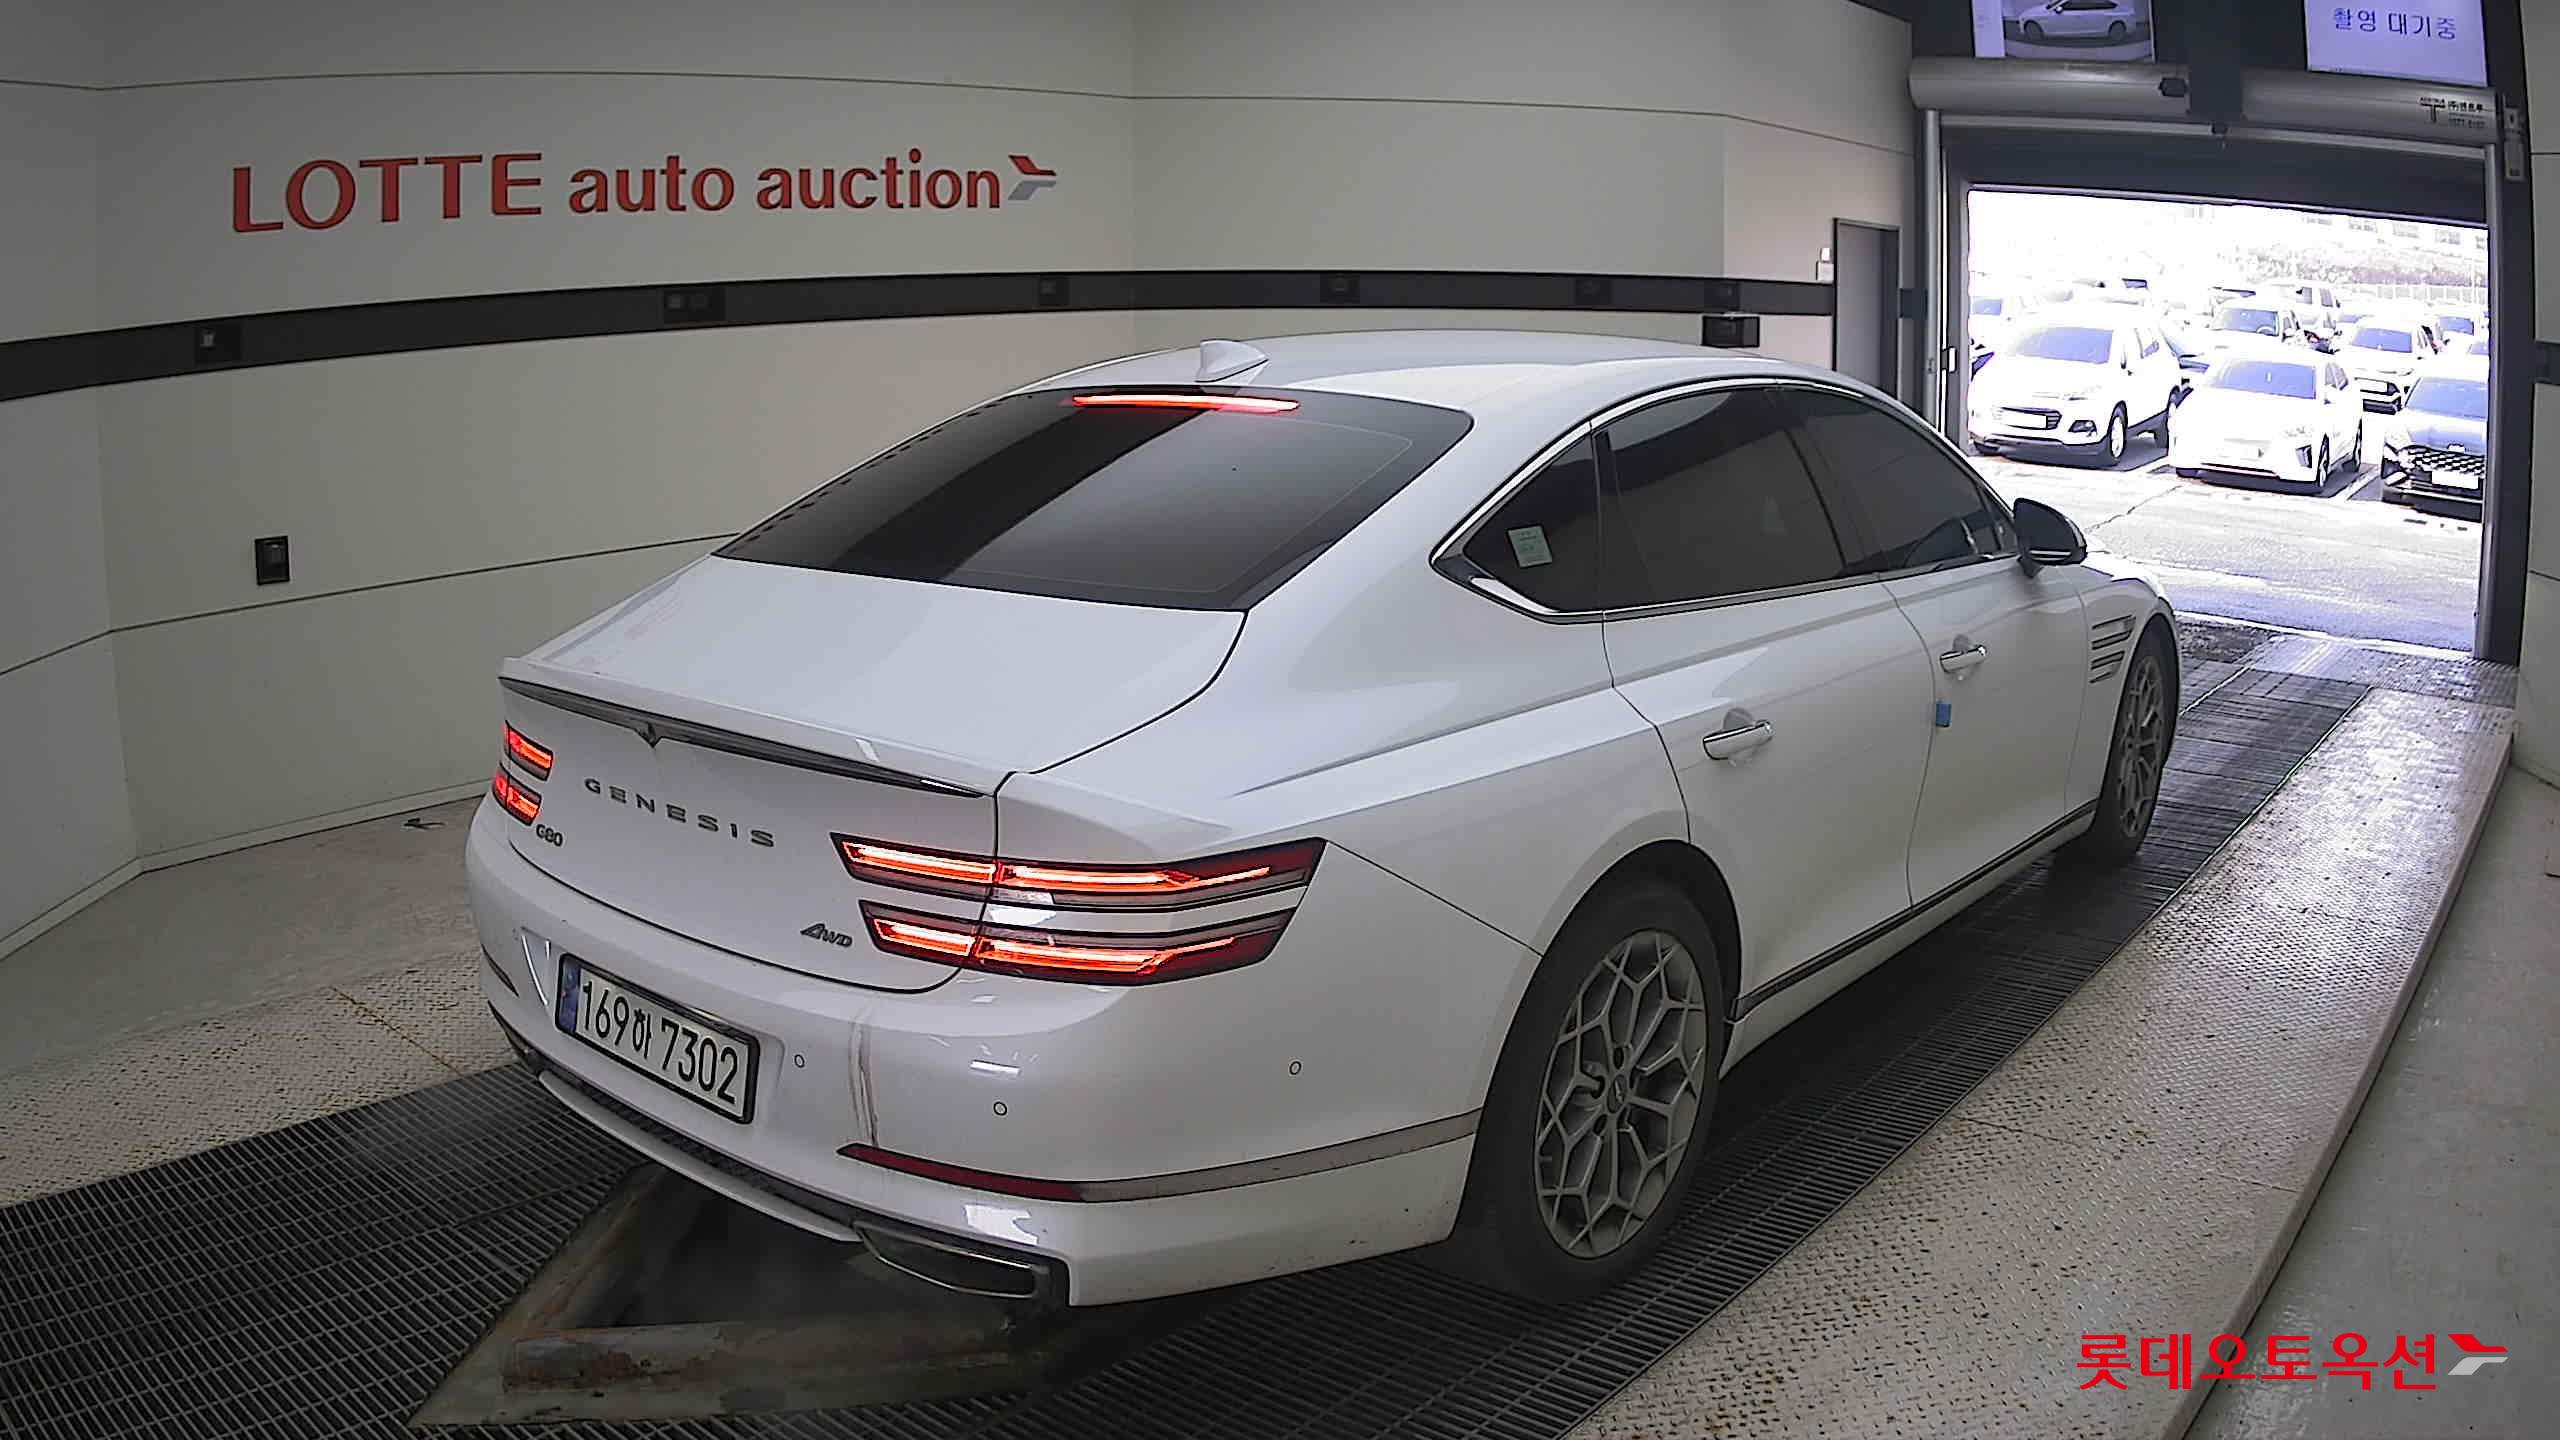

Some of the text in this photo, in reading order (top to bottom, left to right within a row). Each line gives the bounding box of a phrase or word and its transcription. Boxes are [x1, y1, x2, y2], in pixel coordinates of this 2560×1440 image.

[2333, 7, 2457, 40] 촬영 대기중
[232, 147, 1001, 233] LOTTE auto auction
[584, 777, 775, 848] GENESIS
[534, 822, 564, 848] G80
[799, 922, 853, 948] AWD
